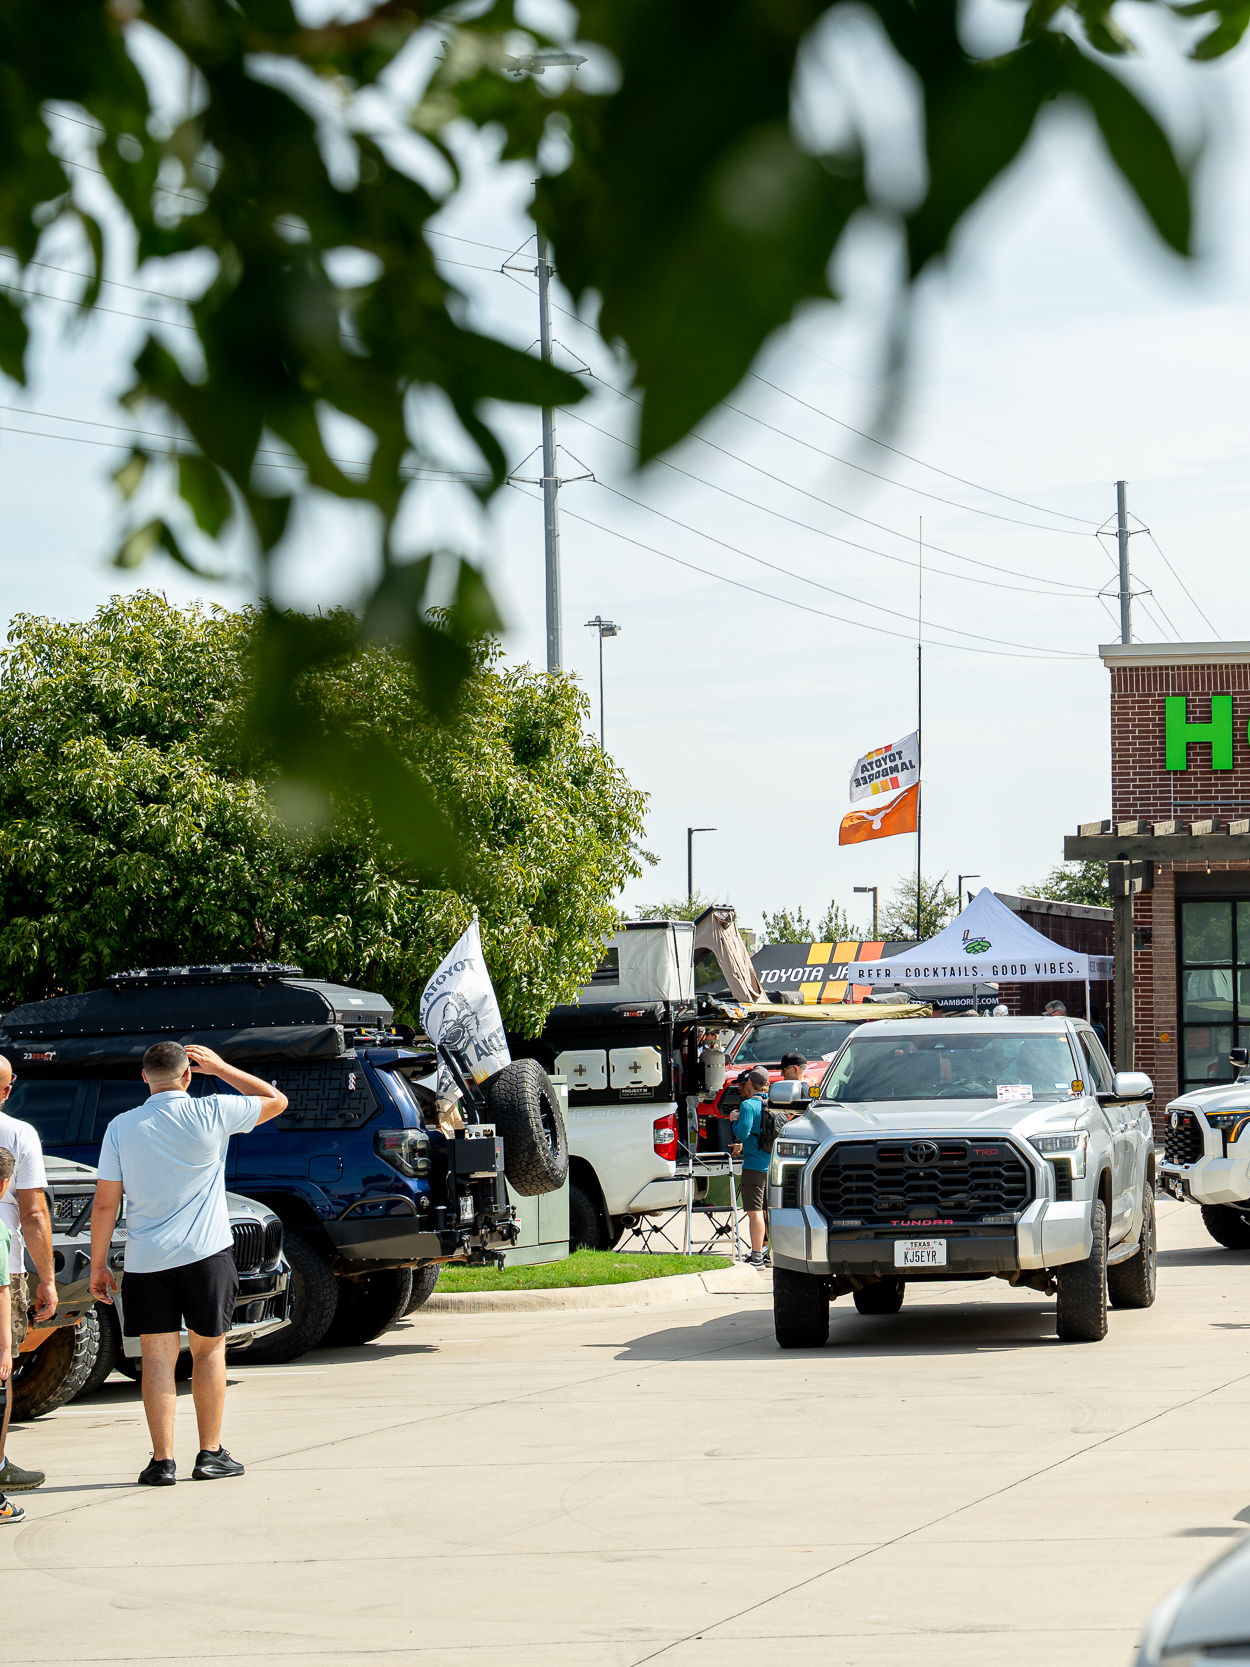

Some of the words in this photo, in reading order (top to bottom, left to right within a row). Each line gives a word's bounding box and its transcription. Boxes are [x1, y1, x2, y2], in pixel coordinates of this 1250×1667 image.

[760, 966, 825, 984] TOYOTA
[905, 966, 984, 978] COCKTAILS.
[992, 964, 1027, 976] GOOD
[1034, 961, 1080, 975] VIBES.
[23, 1052, 53, 1061] 23ZERO
[973, 1148, 999, 1157] TRD
[890, 1219, 954, 1227] TUNDRA
[904, 1250, 937, 1263] KJ5EYR
